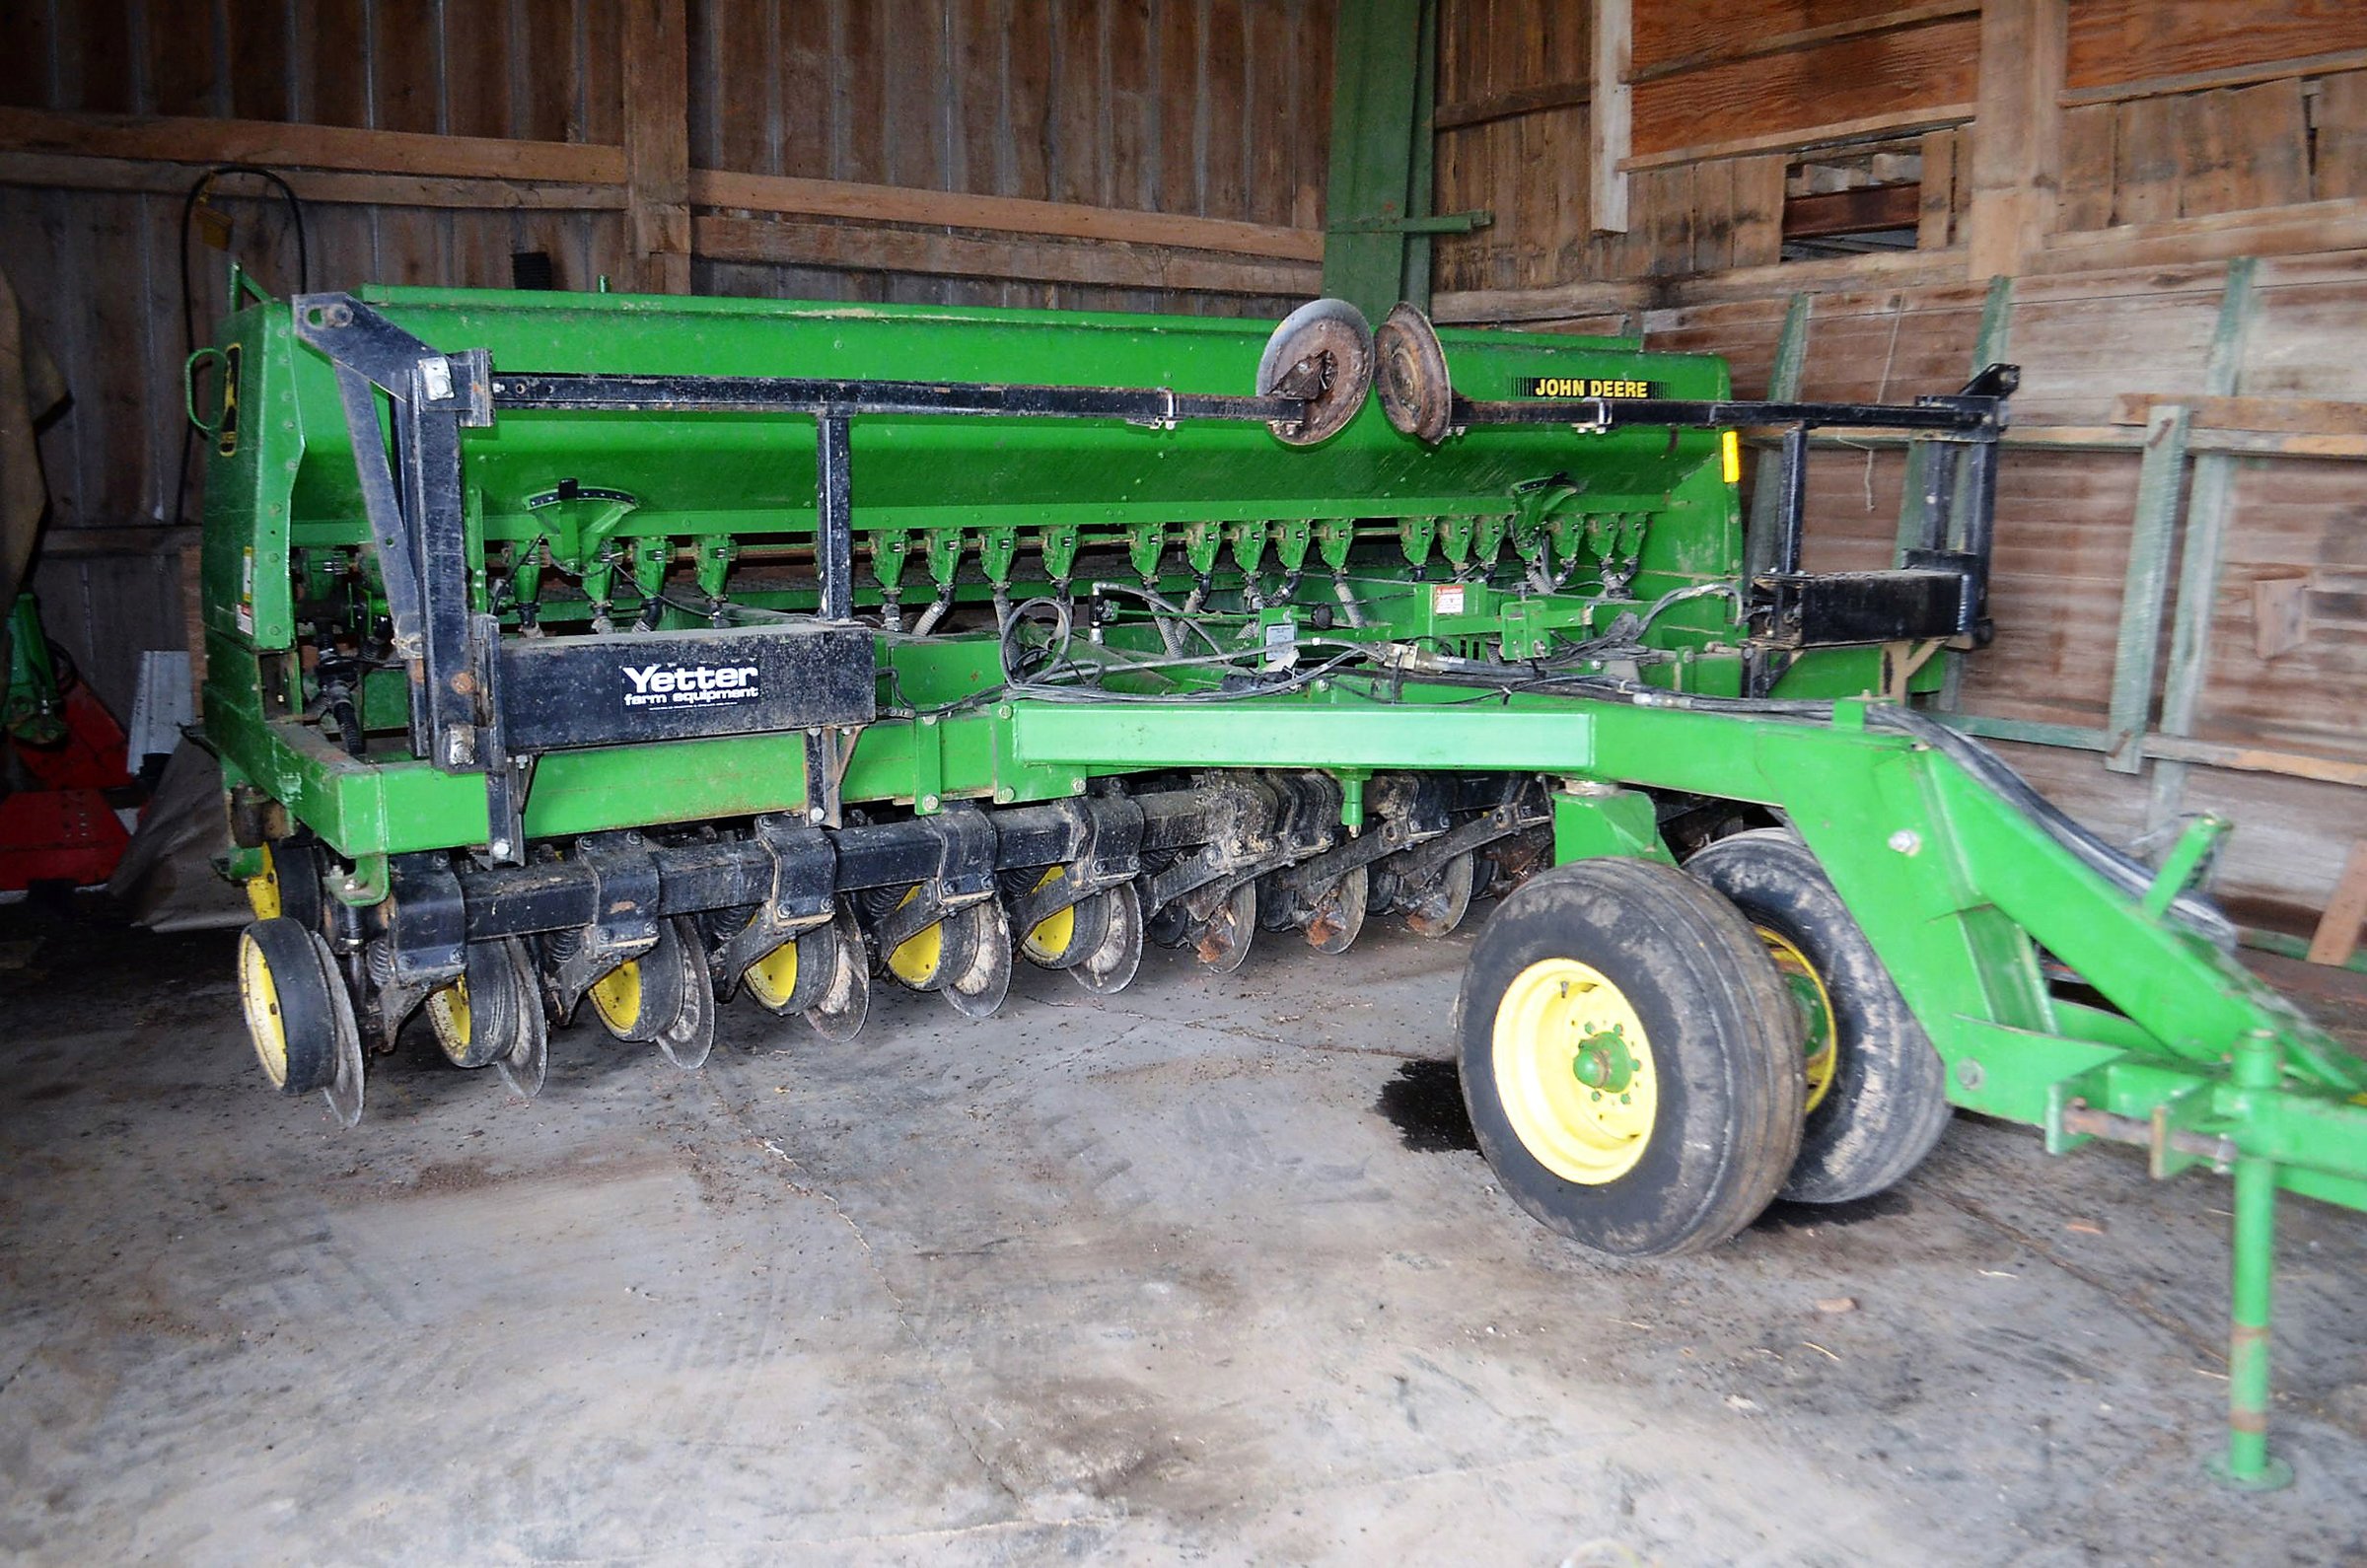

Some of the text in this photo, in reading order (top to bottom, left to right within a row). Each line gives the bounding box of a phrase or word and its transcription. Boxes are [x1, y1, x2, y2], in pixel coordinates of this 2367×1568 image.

[1536, 379, 1648, 398] JOHN DEERE
[622, 665, 758, 693] Yetter
[624, 693, 668, 706] farm
[673, 686, 759, 703] equipment
